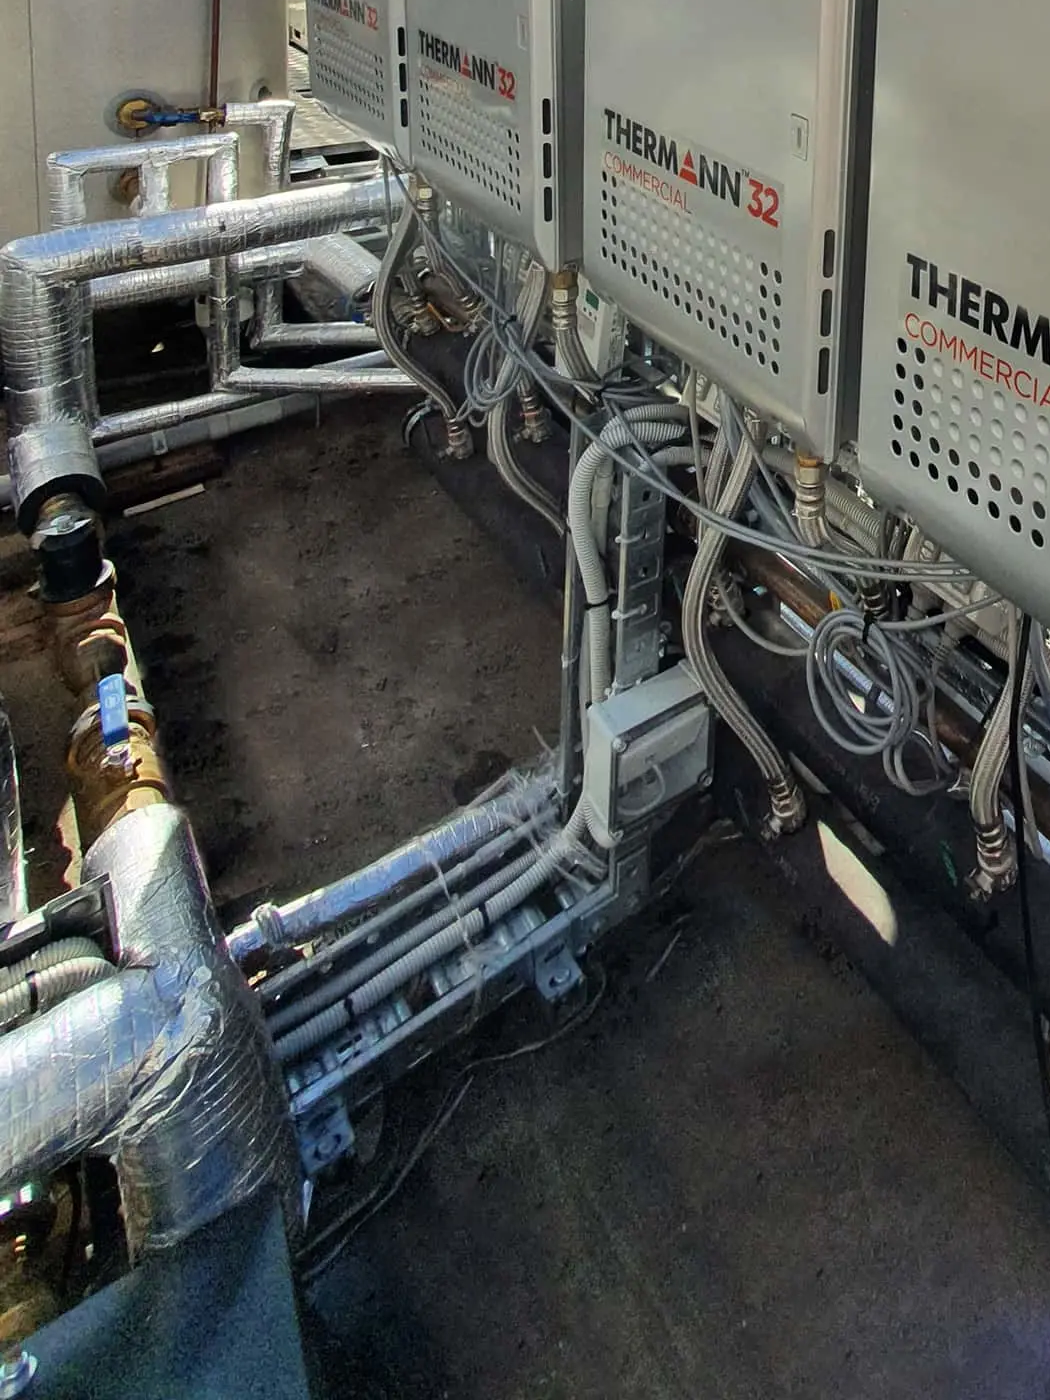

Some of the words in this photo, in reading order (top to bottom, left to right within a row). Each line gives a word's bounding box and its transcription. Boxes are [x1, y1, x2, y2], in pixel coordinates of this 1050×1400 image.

[366, 6, 378, 30] 32
[418, 29, 495, 90] THERMANN
[497, 67, 515, 100] 32
[604, 108, 740, 209] THERMANN
[747, 178, 779, 228] 32
[604, 151, 692, 214] COMMERCIAL
